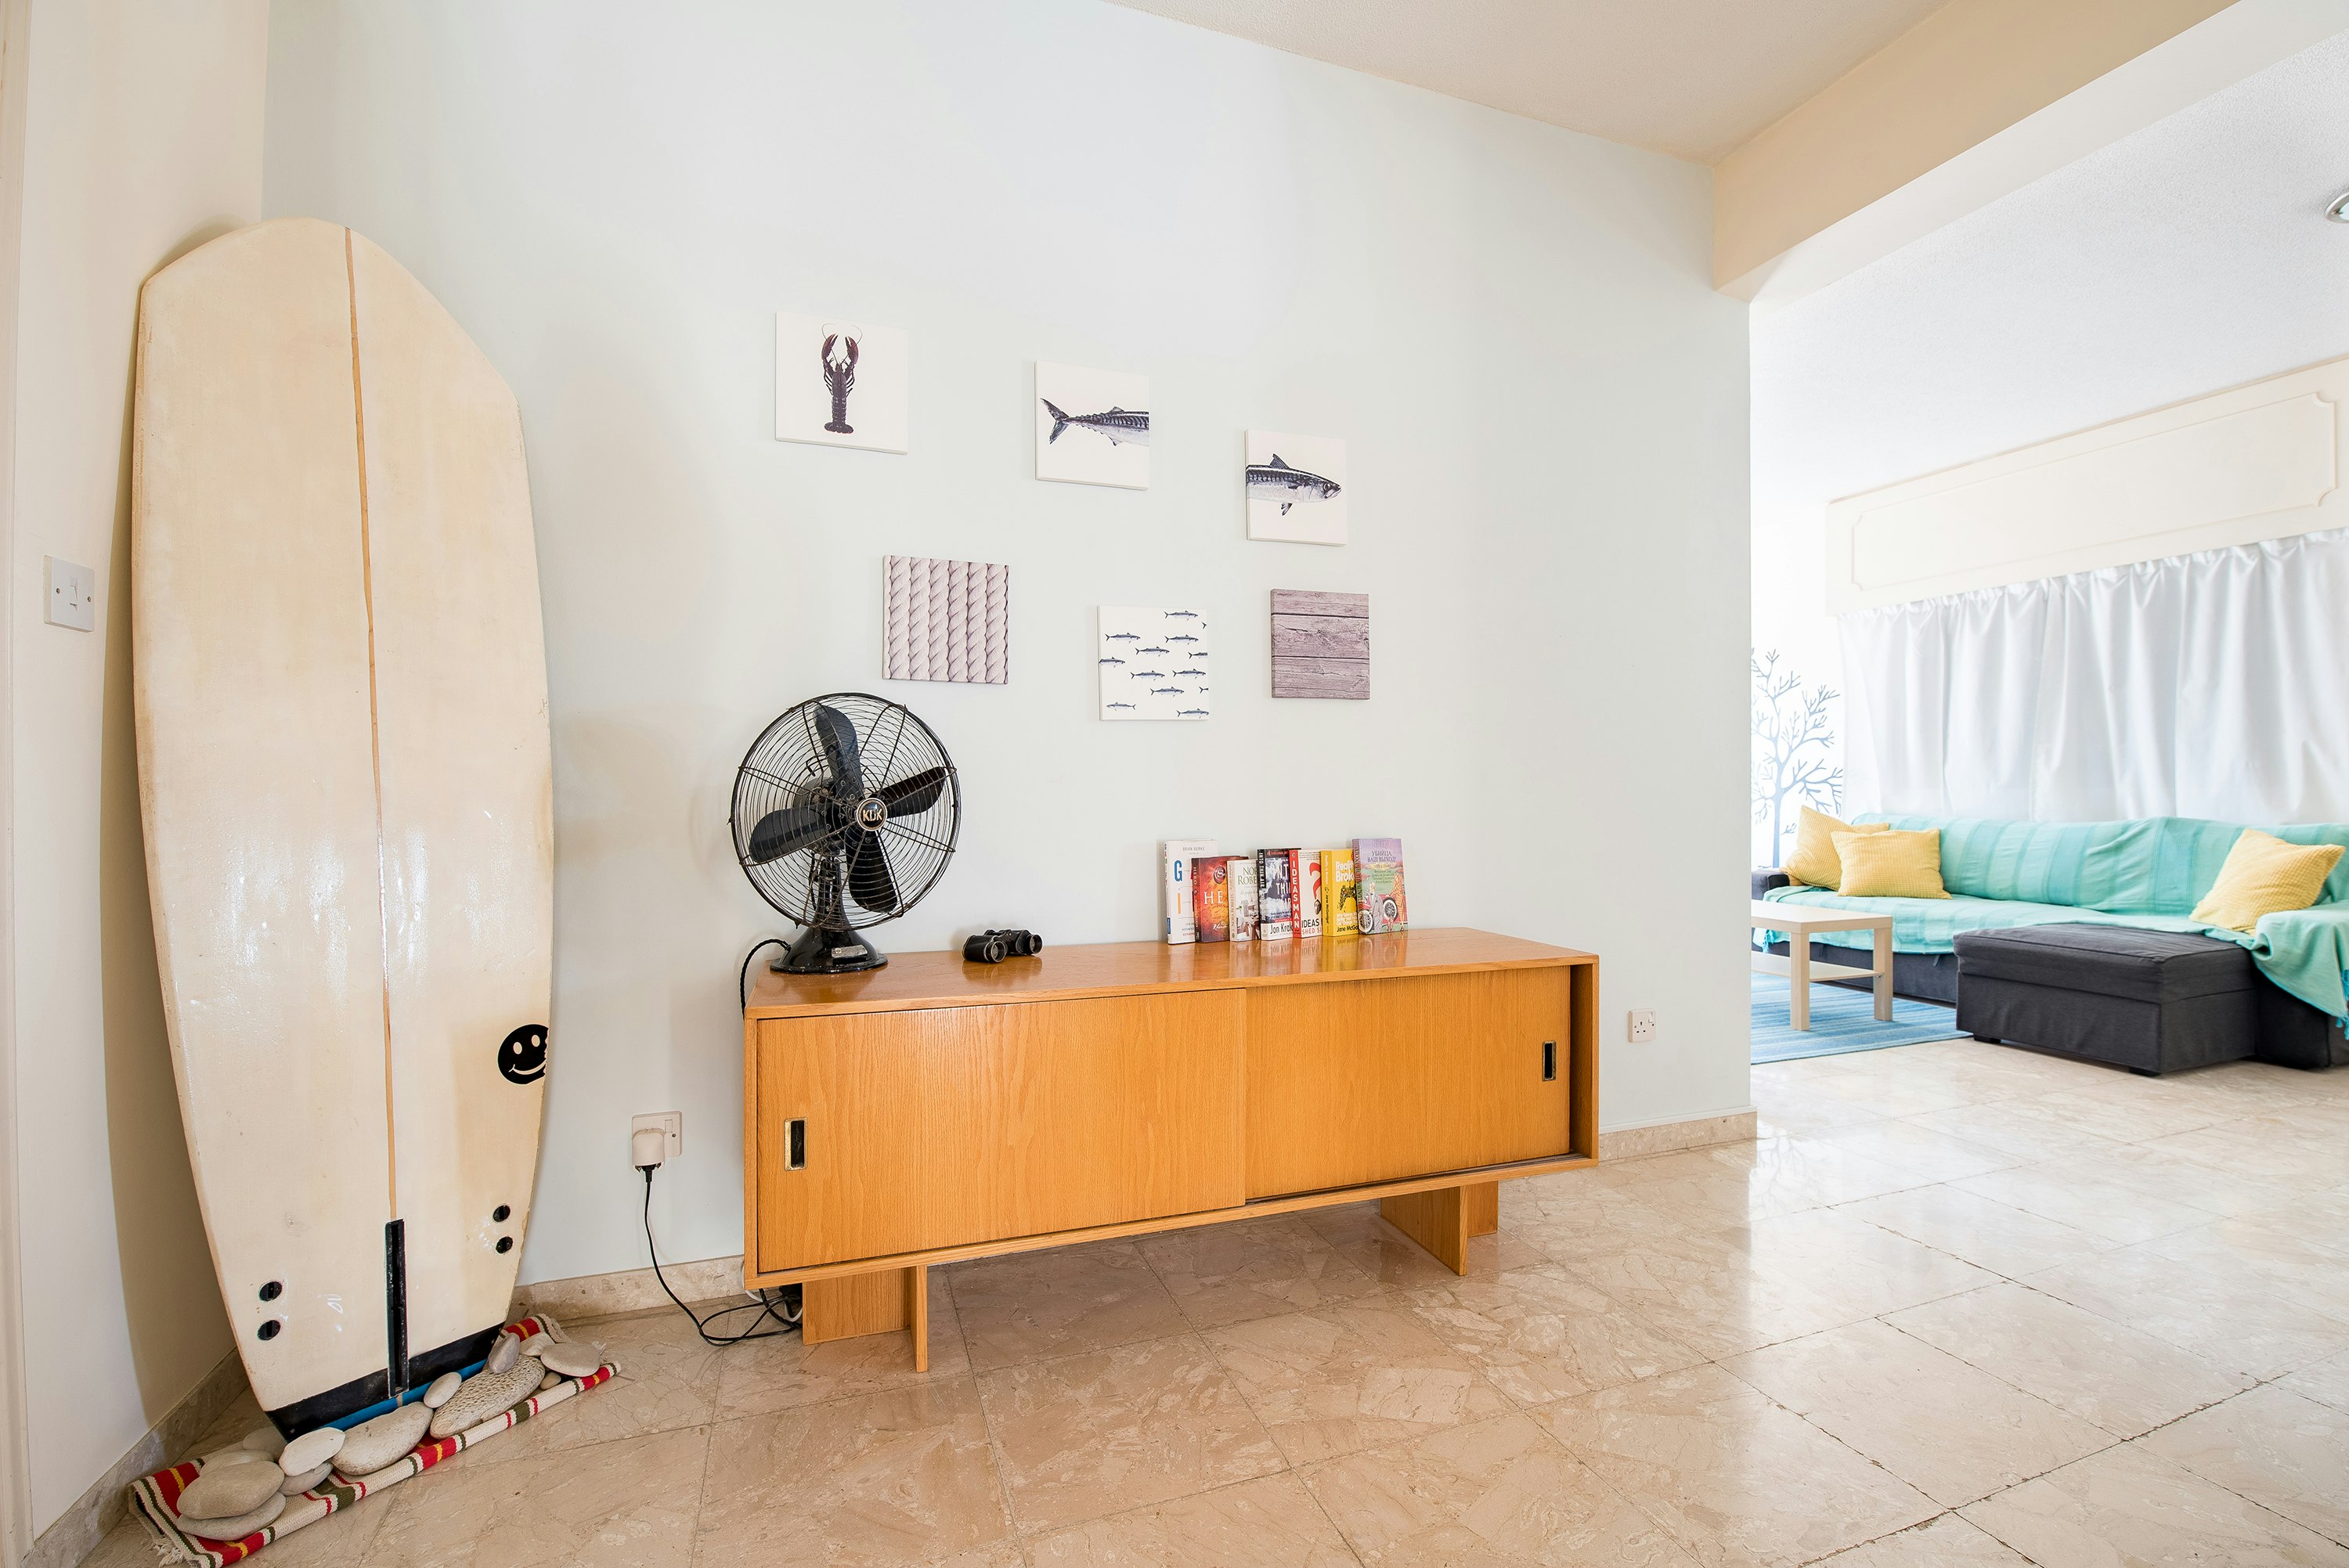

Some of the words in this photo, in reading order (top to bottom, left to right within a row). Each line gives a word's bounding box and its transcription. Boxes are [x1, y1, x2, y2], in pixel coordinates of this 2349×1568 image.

[863, 808, 882, 822] KDK
[1174, 860, 1183, 882] G
[1301, 918, 1319, 928] IDEAS
[1270, 924, 1279, 935] Jon
